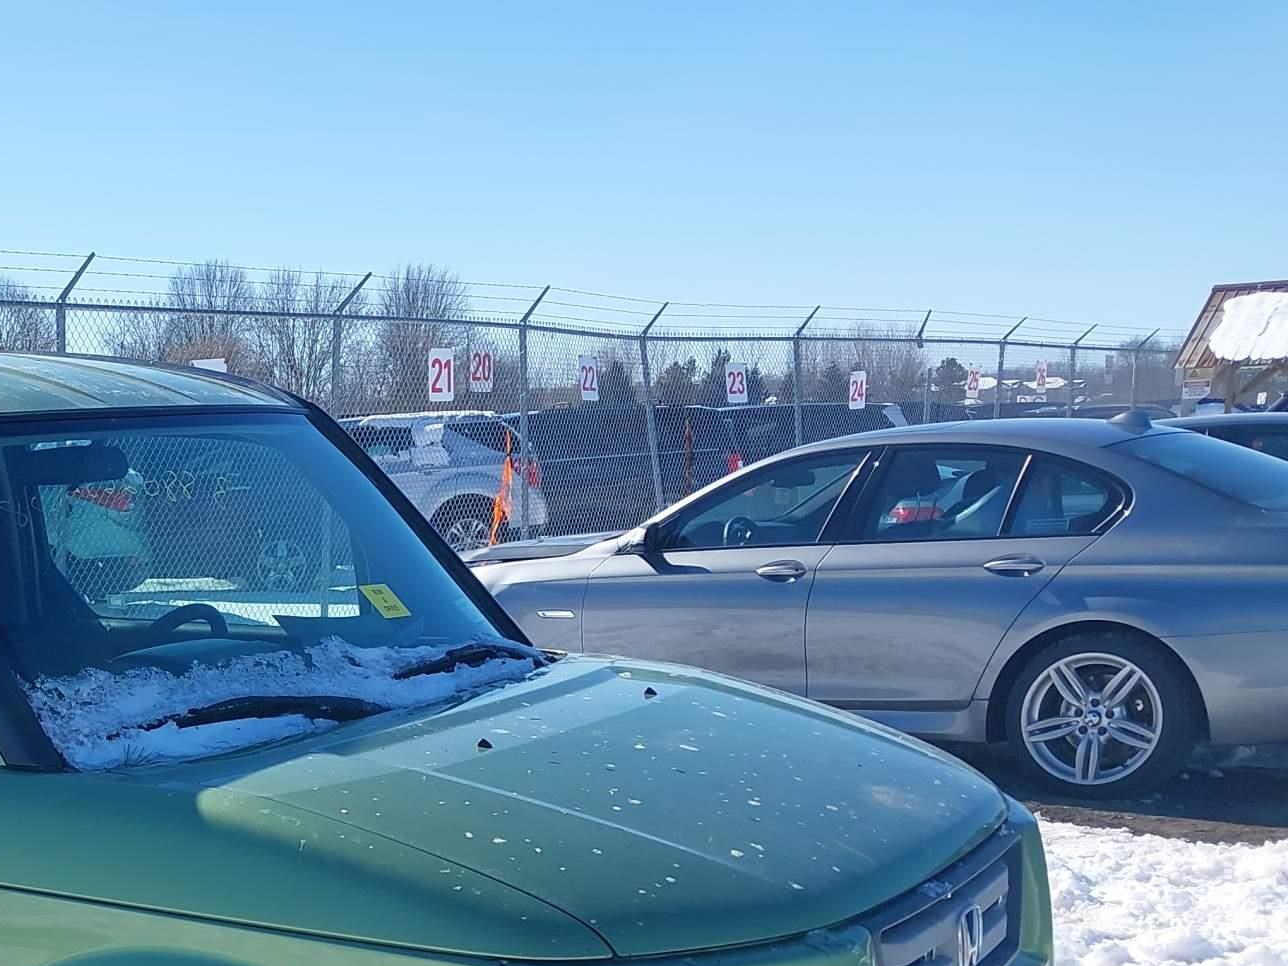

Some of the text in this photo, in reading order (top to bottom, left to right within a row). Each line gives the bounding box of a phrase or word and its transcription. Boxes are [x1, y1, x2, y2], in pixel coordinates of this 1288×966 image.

[430, 357, 453, 394] 21
[471, 351, 492, 382] 20
[580, 365, 596, 392] 22
[727, 370, 745, 395] 23
[850, 379, 865, 403] 24
[967, 370, 980, 391] 25
